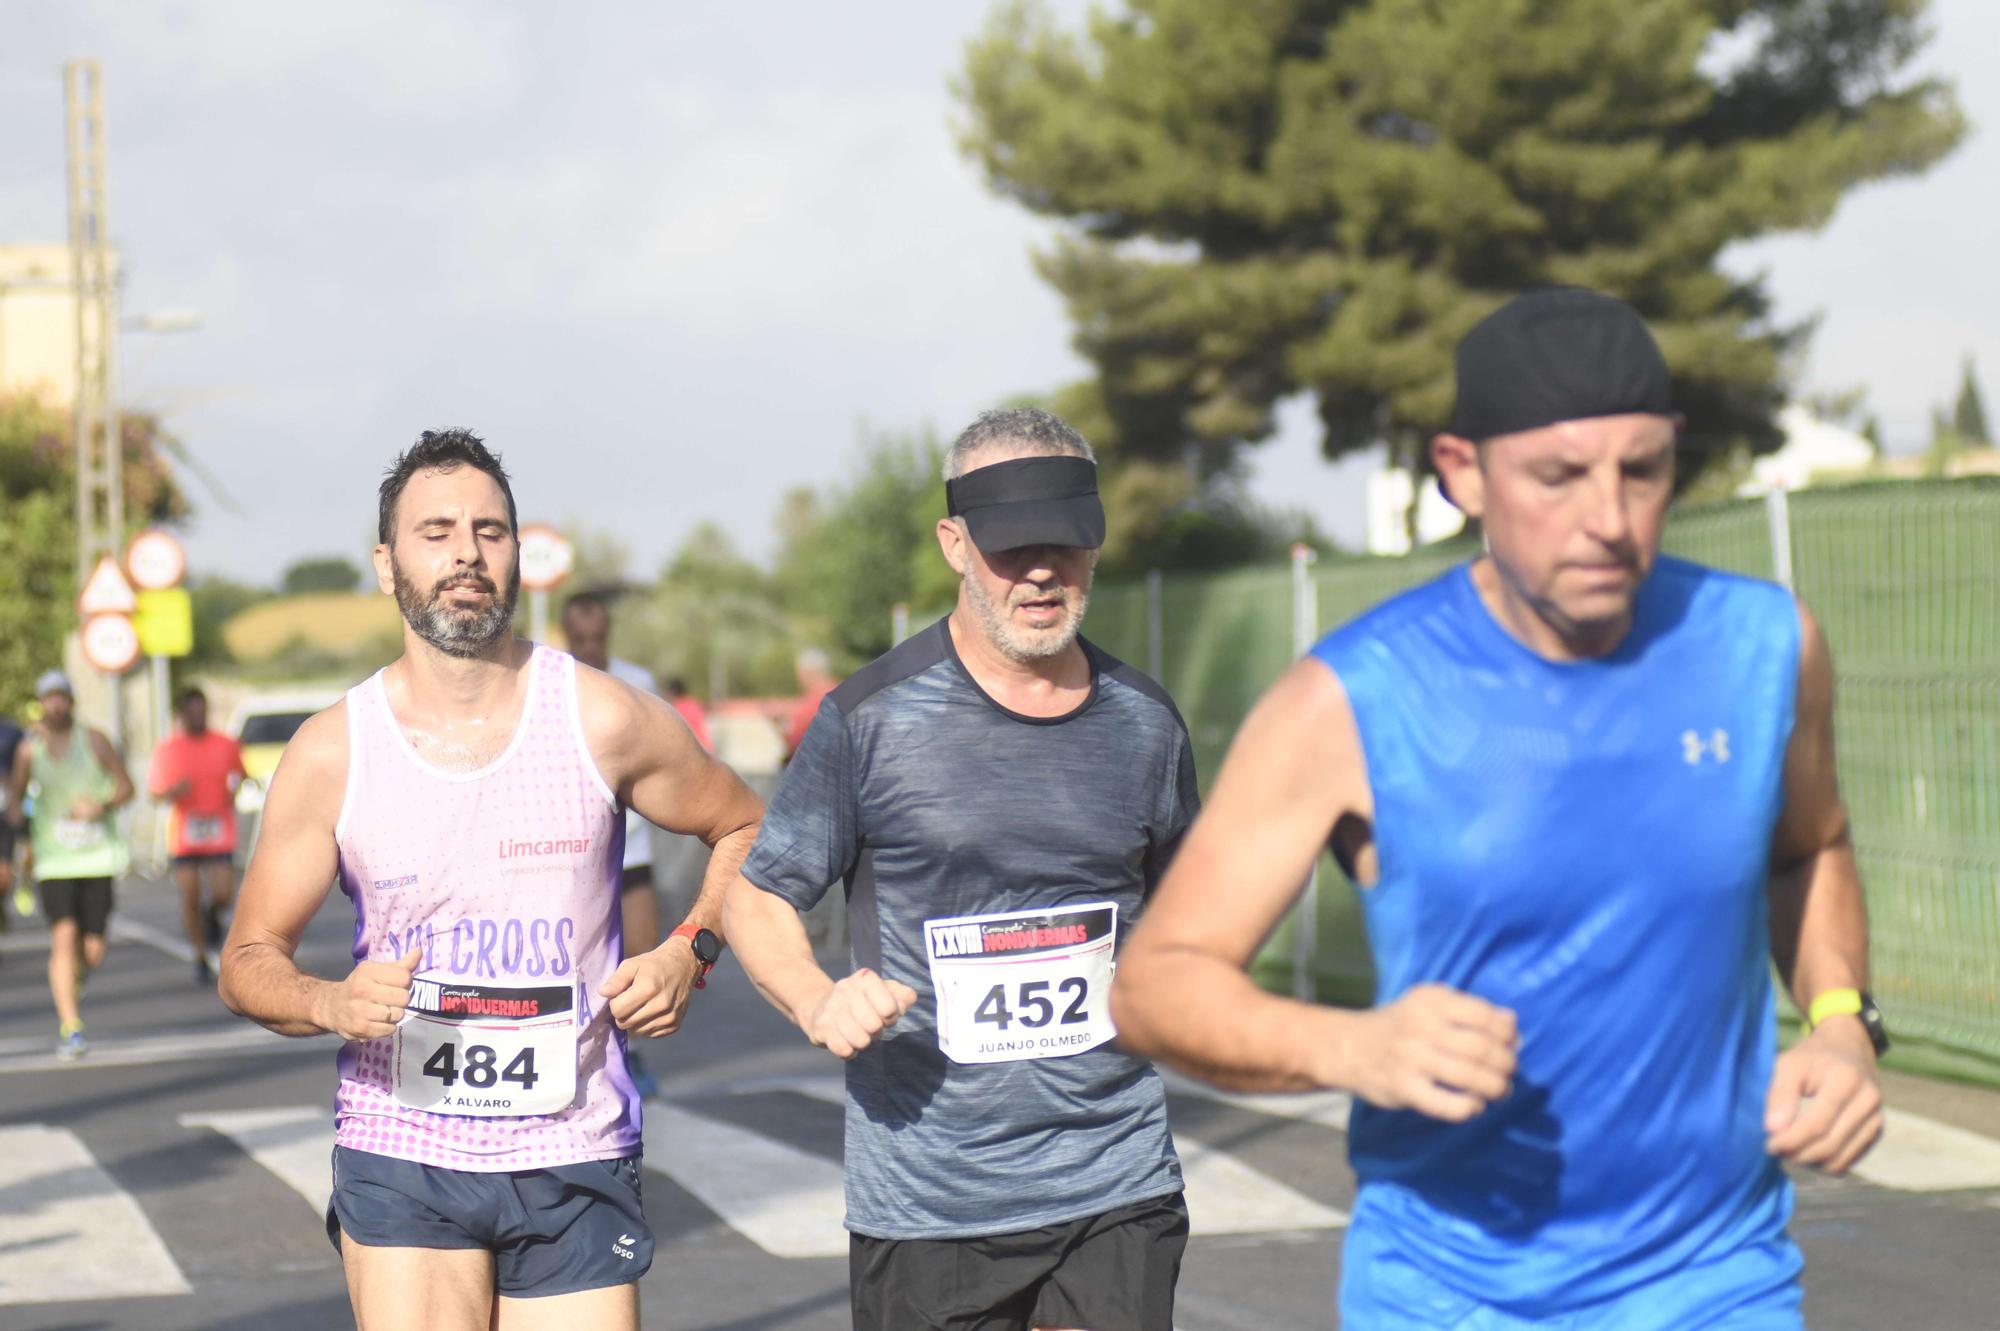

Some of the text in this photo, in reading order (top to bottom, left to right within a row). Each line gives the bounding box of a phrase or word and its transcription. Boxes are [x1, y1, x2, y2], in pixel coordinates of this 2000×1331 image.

[498, 837, 591, 859] Limcamar
[451, 917, 574, 978] CROSS
[983, 925, 1087, 953] NONDUERMAS
[408, 980, 538, 1017] XVIII NONDUERMAS
[974, 977, 1089, 1031] 452
[978, 1033, 1091, 1054] JUANJO OLMEDO
[423, 1042, 539, 1091] 484
[444, 1096, 512, 1108] X ALVARO
